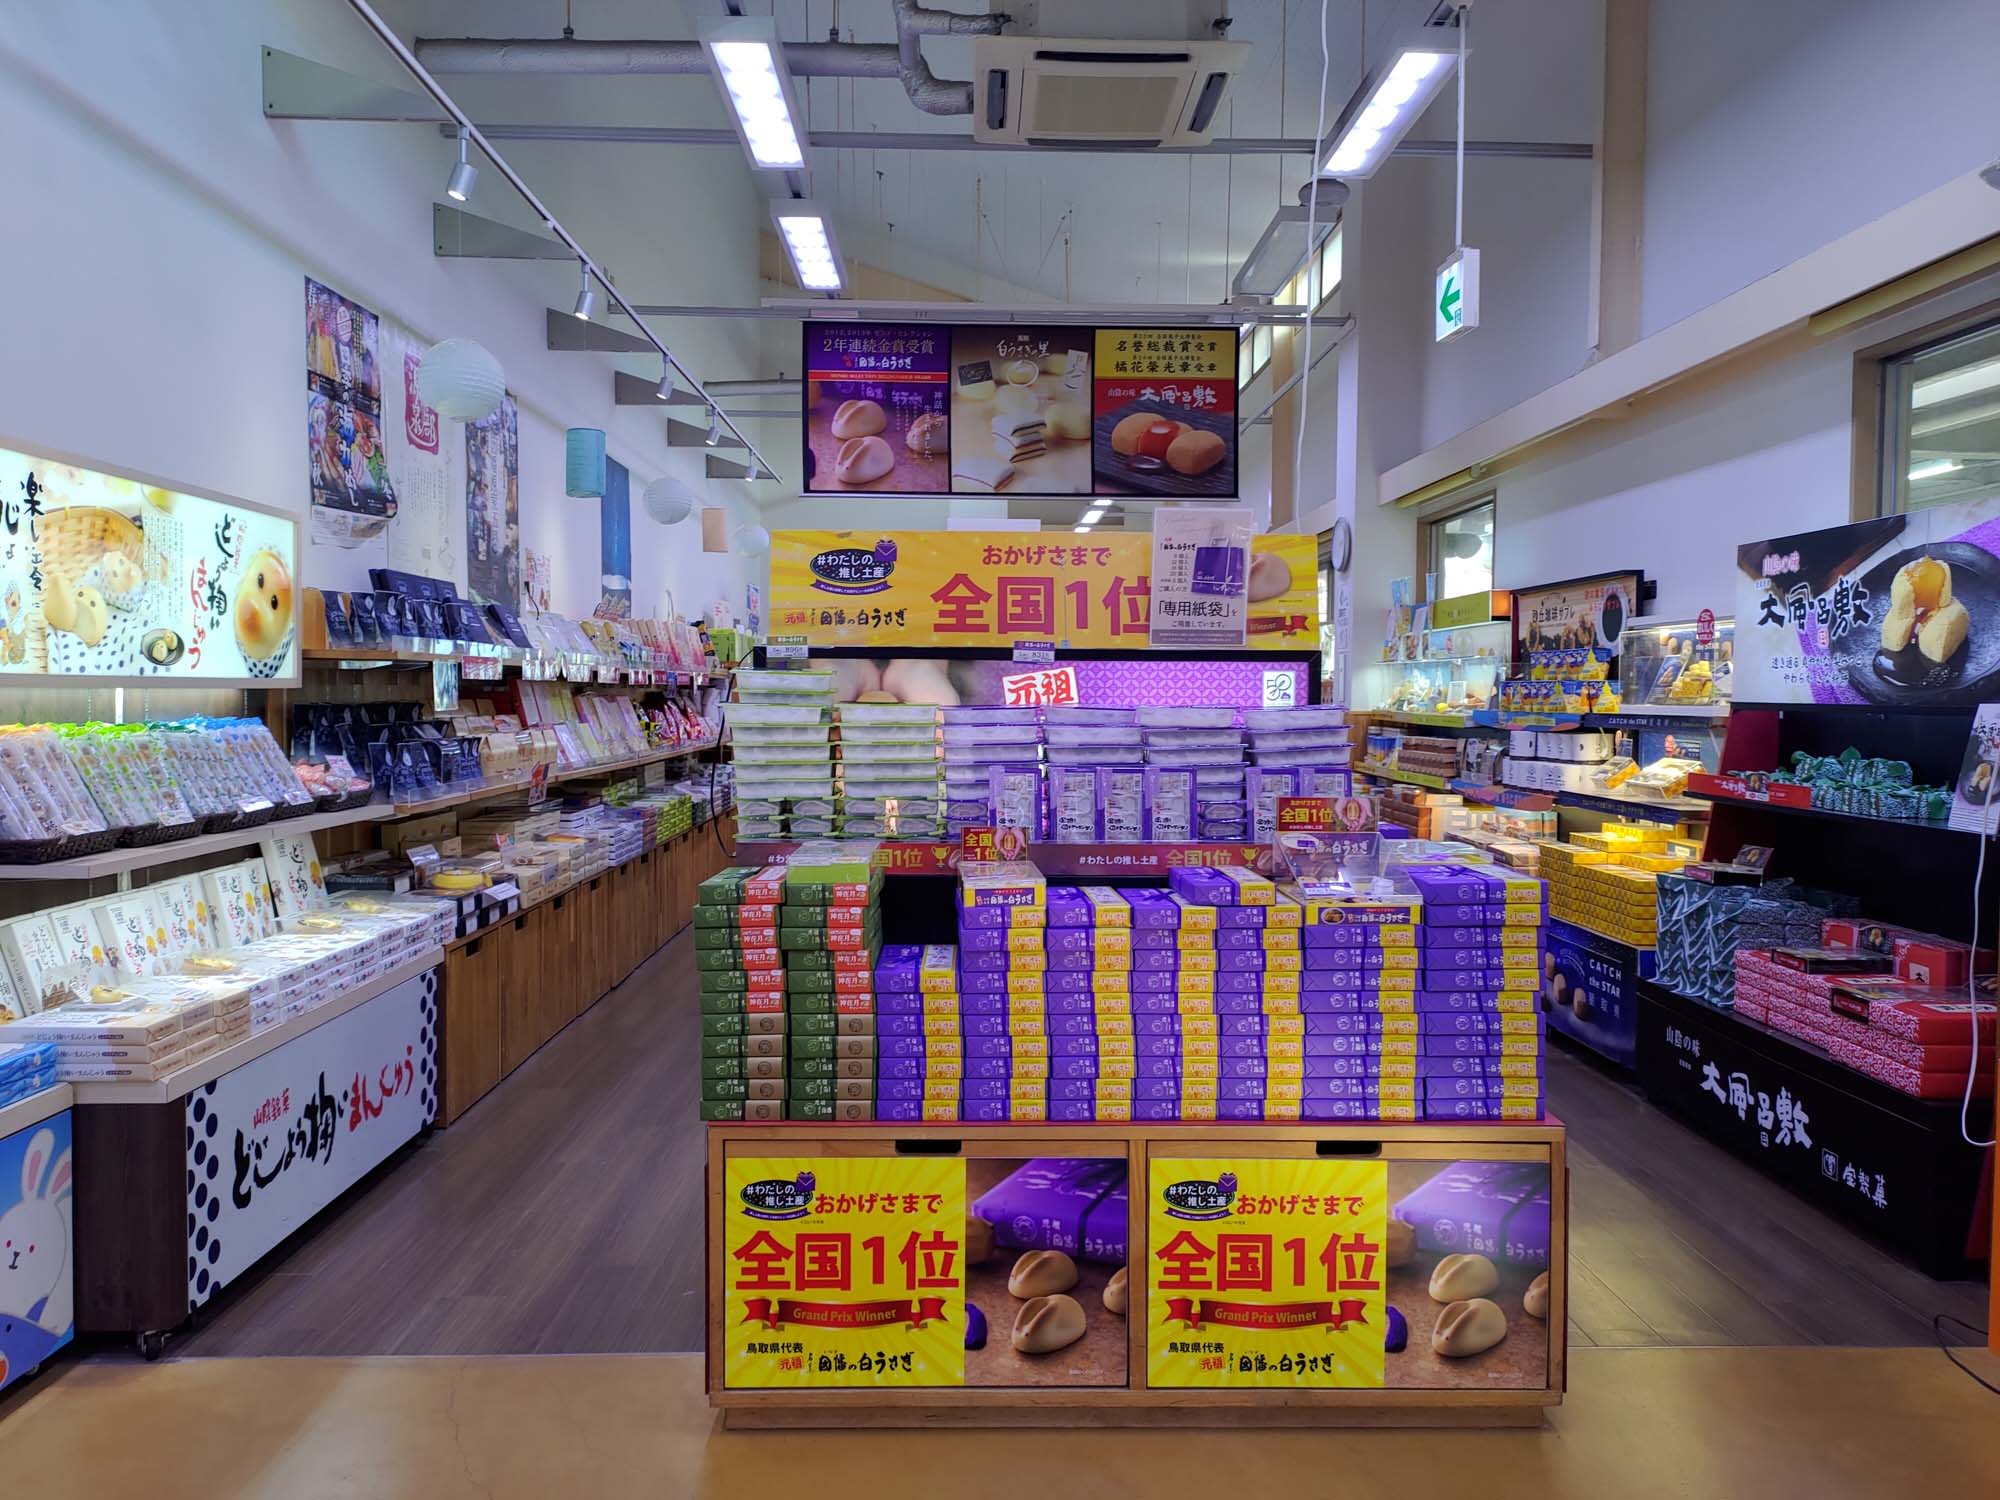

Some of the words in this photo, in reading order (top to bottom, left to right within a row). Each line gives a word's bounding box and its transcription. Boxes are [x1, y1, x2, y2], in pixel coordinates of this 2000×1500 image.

[823, 338, 935, 354] 2年連続金賞受賞
[816, 554, 874, 566] #わたしの
[982, 544, 1112, 568] おかげさまで
[839, 567, 886, 579] 推し土産
[930, 574, 1151, 636] 全国1位
[1757, 576, 1872, 638] 大風呂敷
[1006, 669, 1075, 706] 元祖
[1280, 808, 1334, 823] 全国1位
[964, 833, 993, 847] 全国
[1079, 855, 1159, 866] #わたしの推し土産
[1589, 958, 1622, 982] CATCH
[1601, 980, 1621, 998] STAR
[1699, 1060, 1813, 1149] 大風呂敷
[746, 1185, 795, 1195] #わたしの
[1168, 1185, 1217, 1195] #わたしの
[765, 1195, 805, 1206] 推し土産
[814, 1193, 943, 1214] おかげさまで
[1187, 1196, 1227, 1207] 推し土産
[1236, 1194, 1365, 1216] おかげさまで
[732, 1230, 960, 1292] 全国1位
[1155, 1230, 1380, 1293] 全国1位
[793, 1308, 829, 1322] Grand
[830, 1311, 851, 1323] Prix
[855, 1308, 897, 1323] Winner
[1214, 1308, 1250, 1323] Grand
[1251, 1311, 1273, 1323] Prix
[1275, 1310, 1318, 1324] Winner
[745, 1342, 803, 1354] 鳥取県代表
[1168, 1342, 1225, 1354] 鳥取県代表
[1200, 1355, 1225, 1371] 元祖
